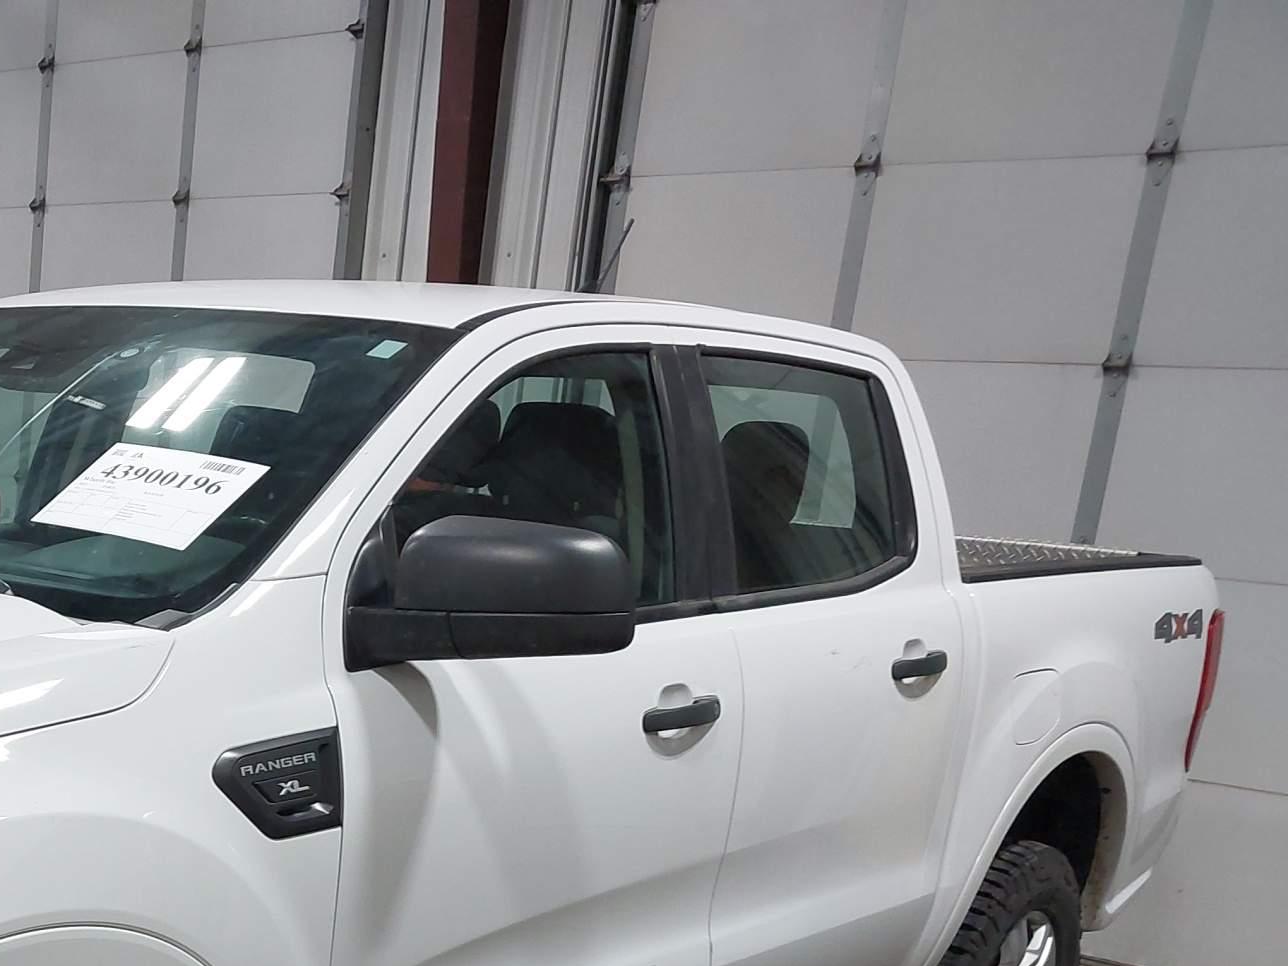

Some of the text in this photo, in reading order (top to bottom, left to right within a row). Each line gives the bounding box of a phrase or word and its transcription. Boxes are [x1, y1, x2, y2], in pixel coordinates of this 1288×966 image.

[100, 463, 230, 495] 43900196
[239, 752, 317, 776] RANGER
[277, 780, 310, 795] XL
